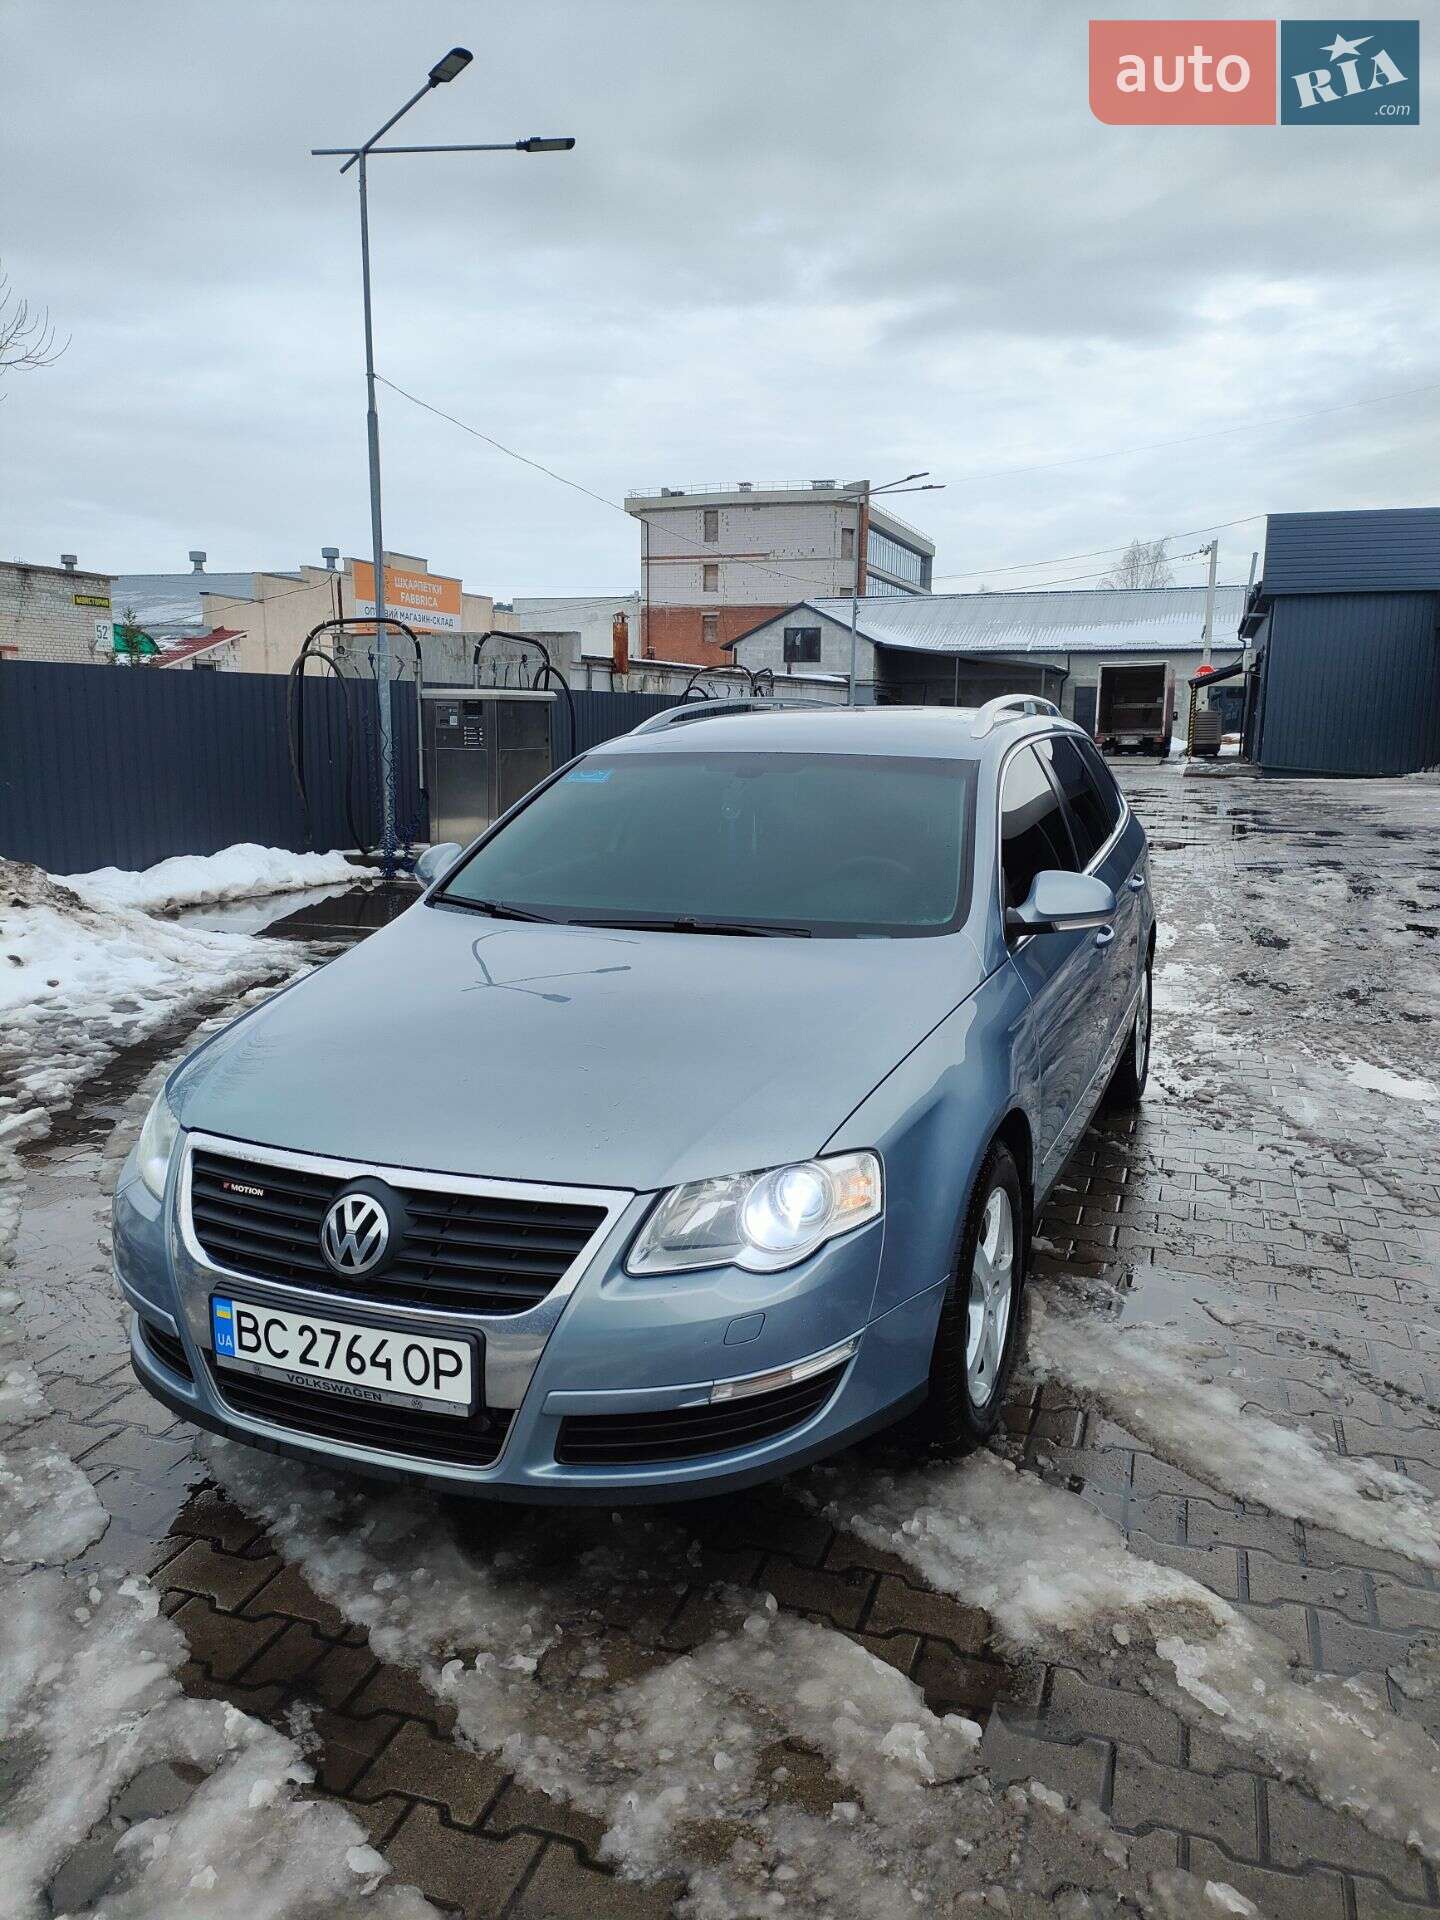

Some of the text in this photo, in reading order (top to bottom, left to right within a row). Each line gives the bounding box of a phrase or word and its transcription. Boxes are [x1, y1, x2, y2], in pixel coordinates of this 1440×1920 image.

[400, 592, 438, 607] FABBRICA
[365, 606, 399, 619] ОПВИЙ
[96, 624, 108, 640] 52
[217, 1332, 233, 1348] UA
[236, 1310, 463, 1390] BC 2764 OP
[286, 1373, 382, 1401] VOLKSWAGEN
